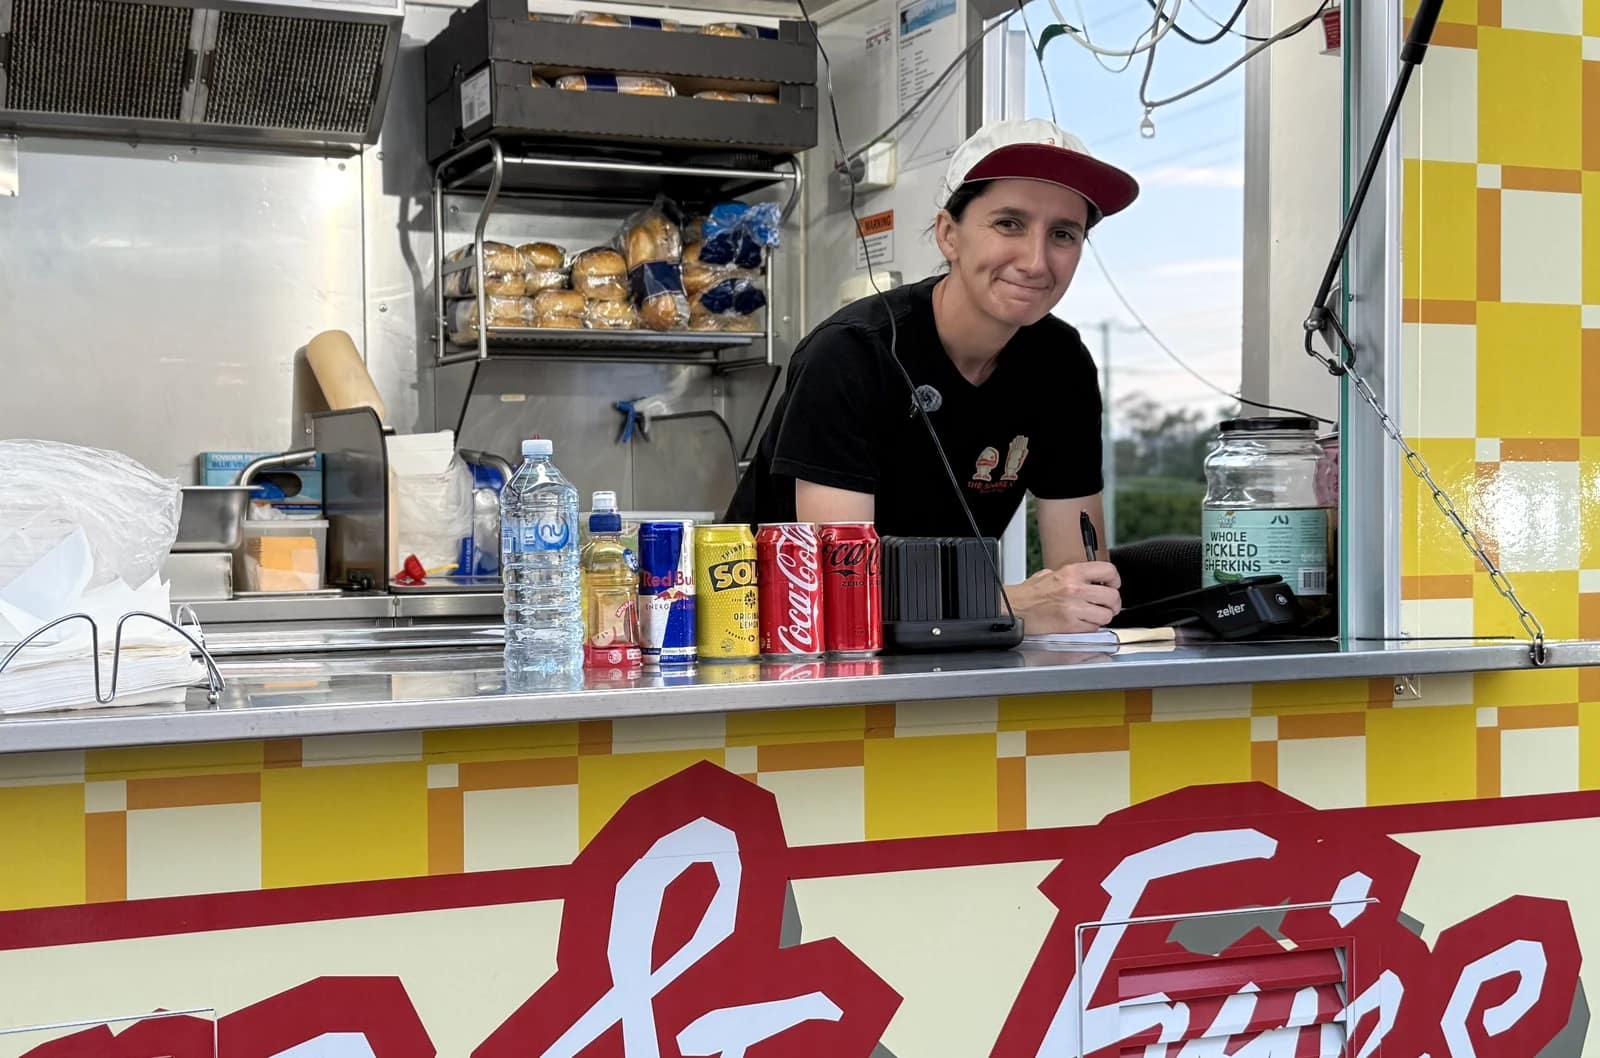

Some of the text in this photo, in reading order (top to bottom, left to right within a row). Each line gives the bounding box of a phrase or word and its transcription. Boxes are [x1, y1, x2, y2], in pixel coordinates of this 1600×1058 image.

[864, 214, 891, 231] WARNING
[1210, 531, 1247, 542] WHOLE
[1205, 543, 1258, 557] PICKLED
[1204, 559, 1261, 572] GHERKINS
[643, 570, 672, 587] Red
[713, 561, 758, 588] SOL
[777, 525, 818, 653] Coca-Cola
[1216, 603, 1246, 618] zeller
